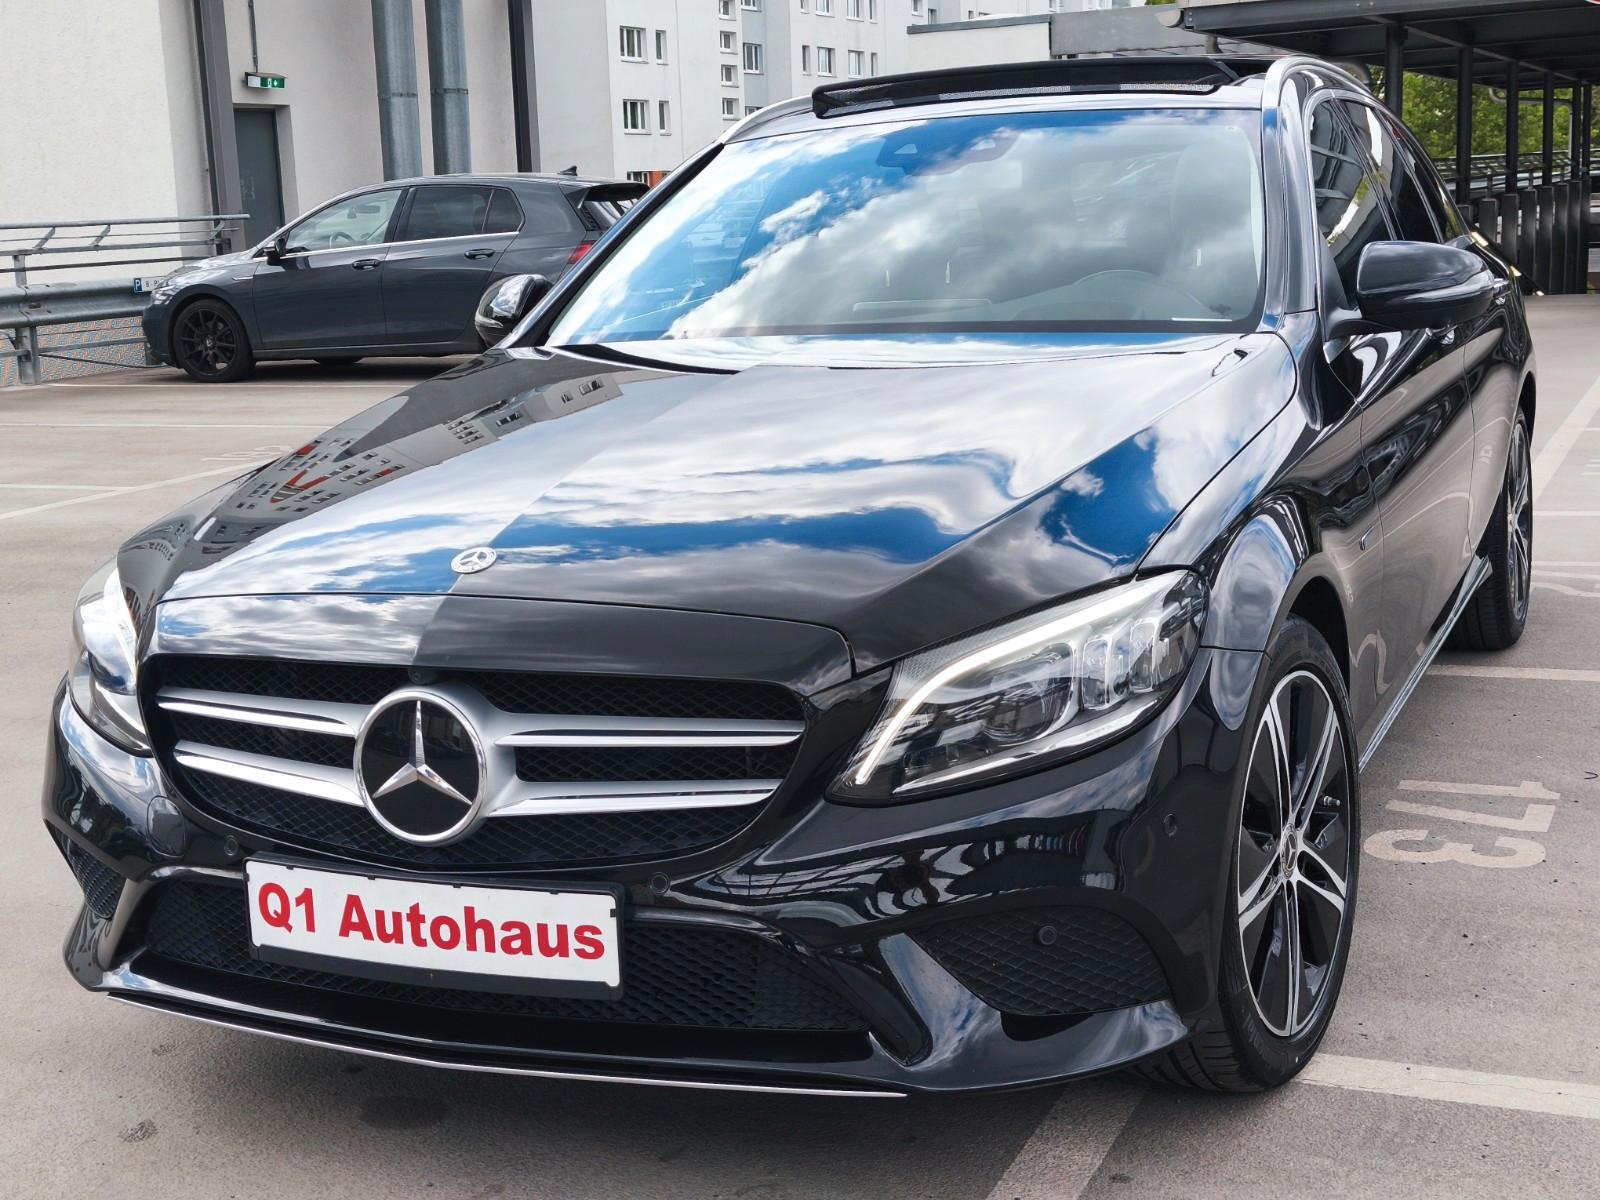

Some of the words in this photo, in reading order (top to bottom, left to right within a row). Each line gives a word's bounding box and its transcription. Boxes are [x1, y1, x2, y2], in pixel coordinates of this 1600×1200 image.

[1363, 779, 1561, 869] 173
[258, 882, 316, 934] Q1
[338, 894, 606, 961] Autohaus
